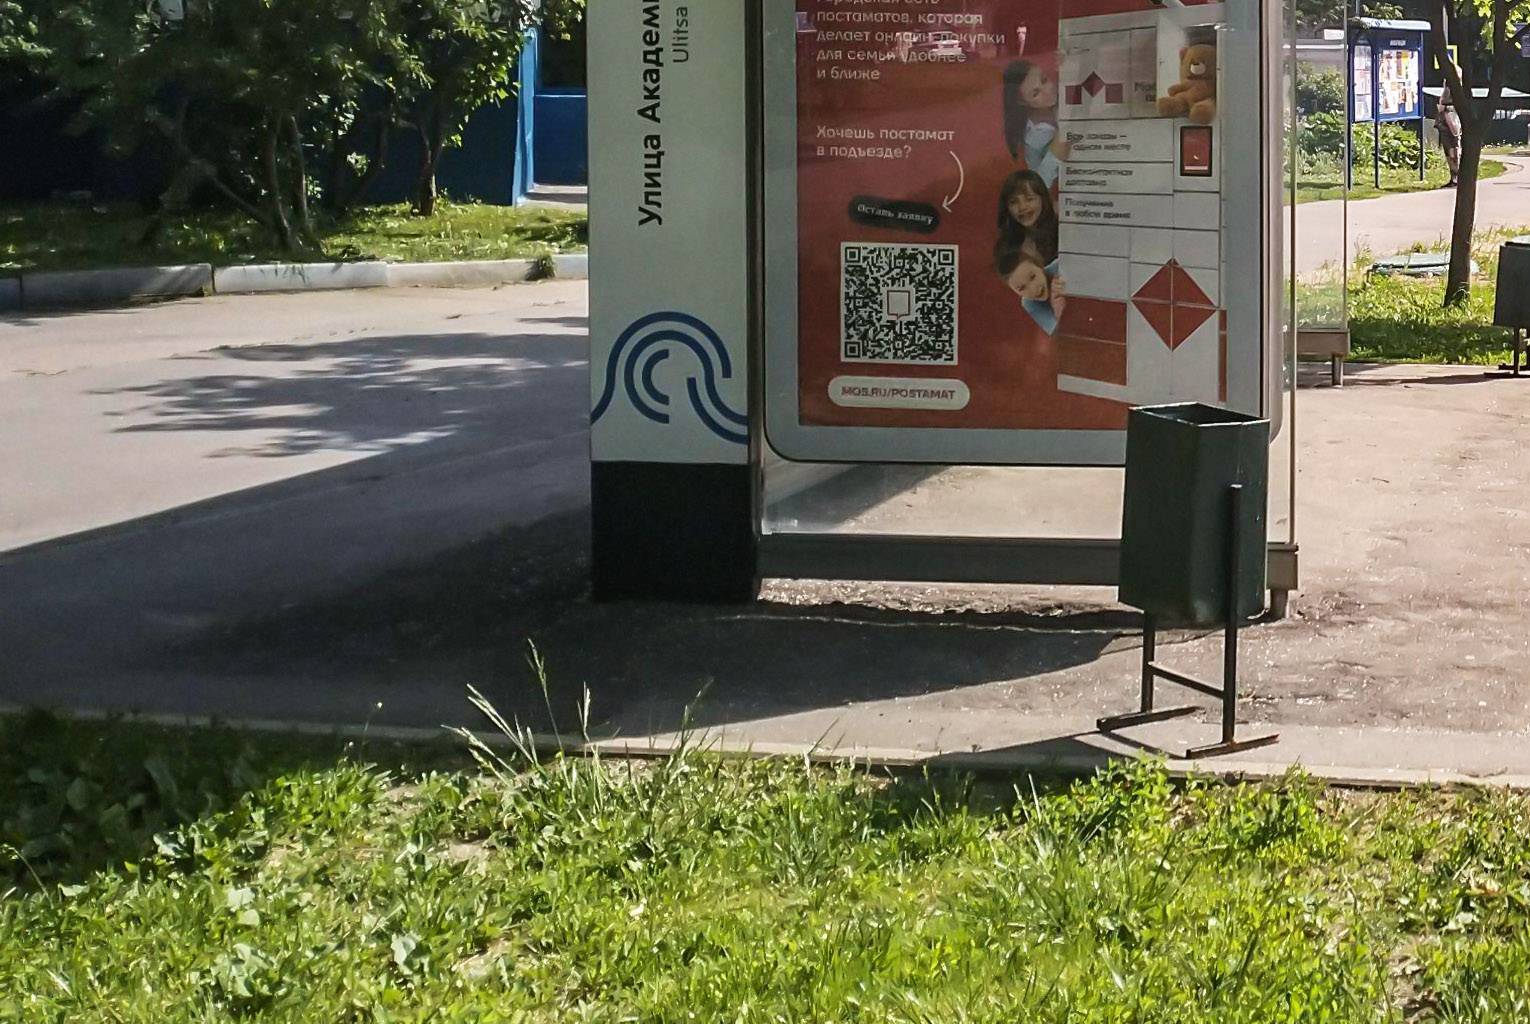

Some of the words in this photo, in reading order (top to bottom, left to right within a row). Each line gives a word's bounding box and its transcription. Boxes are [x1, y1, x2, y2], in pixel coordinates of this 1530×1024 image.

[918, 13, 983, 28] которая
[672, 6, 689, 63] Ulitsa
[816, 31, 870, 43] делает
[816, 49, 842, 62] для
[816, 70, 826, 79] и
[830, 67, 880, 81] ближе
[816, 125, 875, 140] Хочешь
[879, 129, 956, 141] постамат
[816, 147, 825, 156] в
[829, 144, 912, 159] подъезде?
[638, 133, 664, 226] Улица
